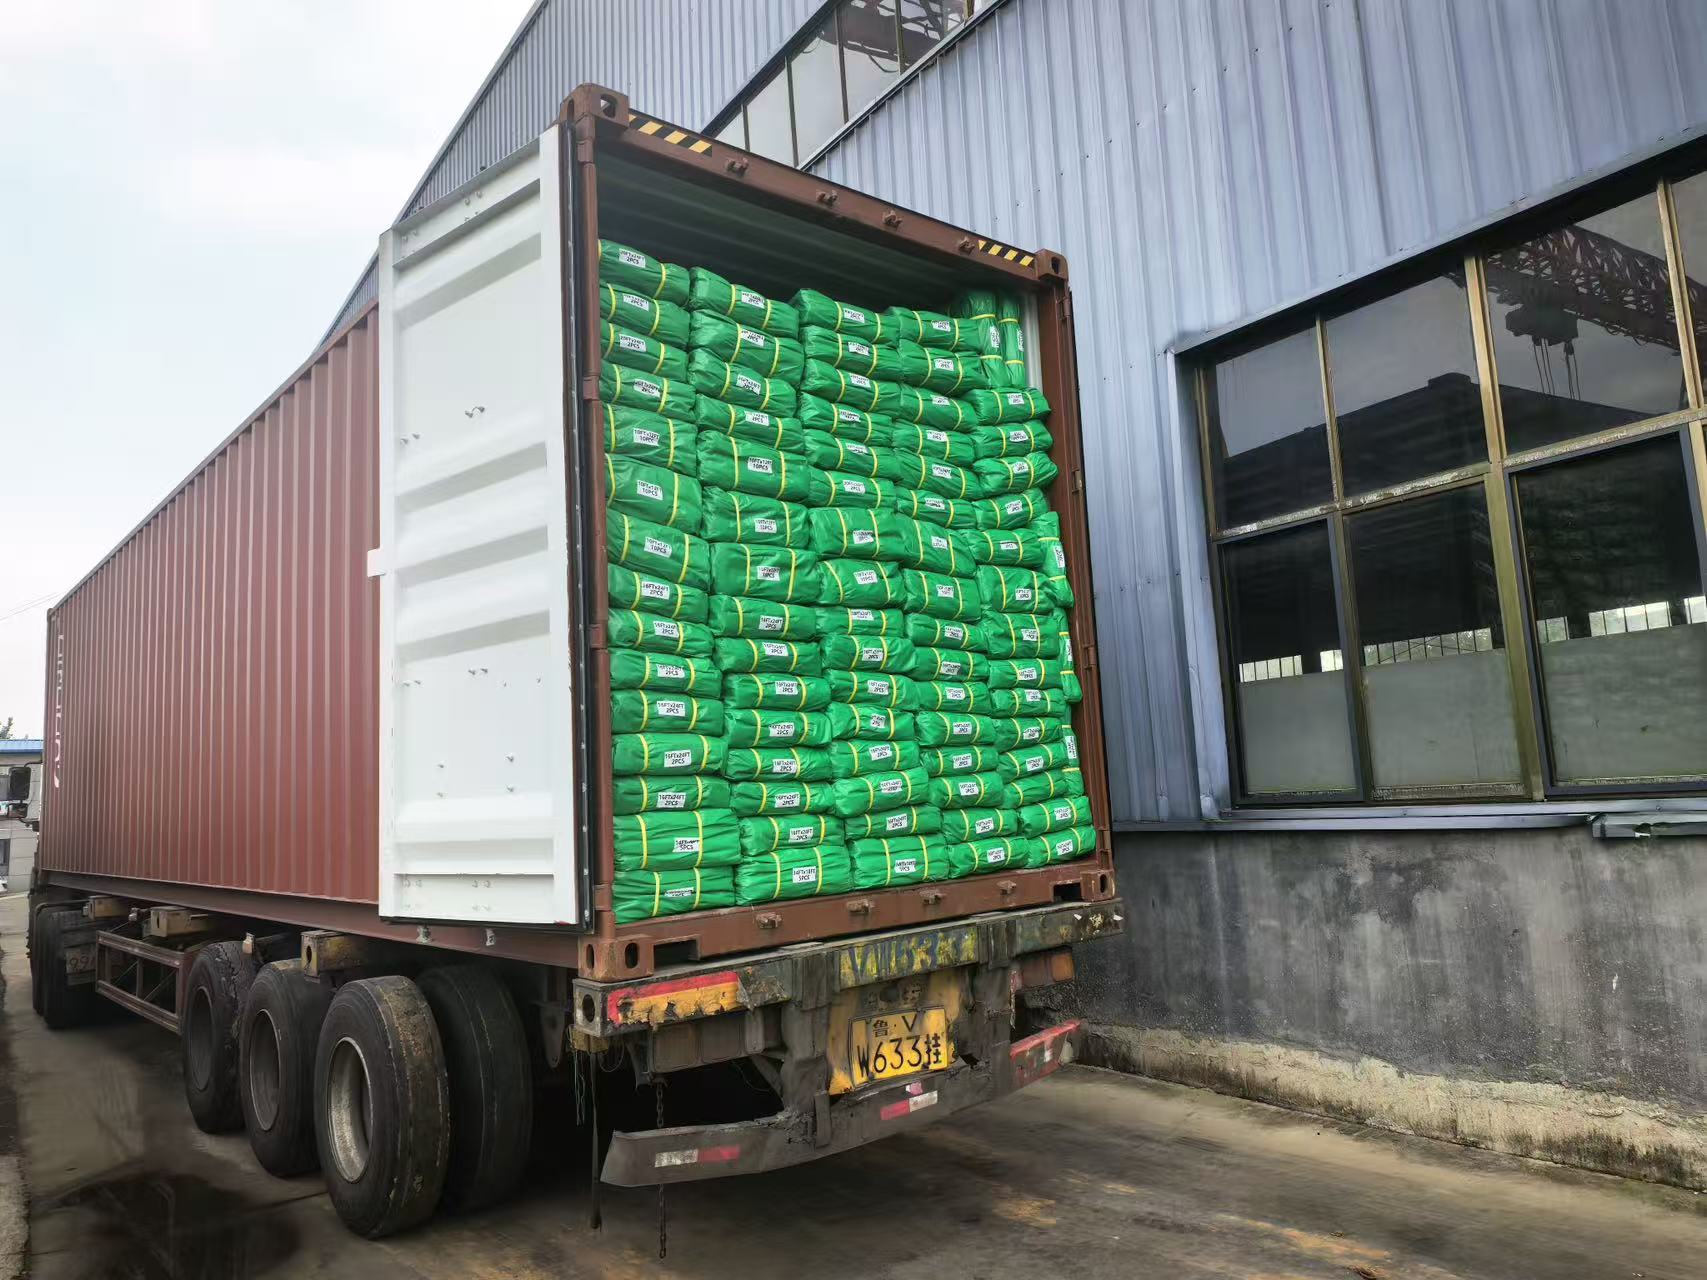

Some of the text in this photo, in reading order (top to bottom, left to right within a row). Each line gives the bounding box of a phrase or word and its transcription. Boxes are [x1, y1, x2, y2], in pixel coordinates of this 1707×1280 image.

[626, 257, 639, 265] 2PCS
[753, 463, 769, 471] 10PCS
[643, 488, 658, 497] 10PCS
[651, 545, 667, 554] 10PCS
[649, 589, 664, 597] 2PCS
[671, 757, 685, 765] 2PCS
[857, 1032, 942, 1078] W633挂
